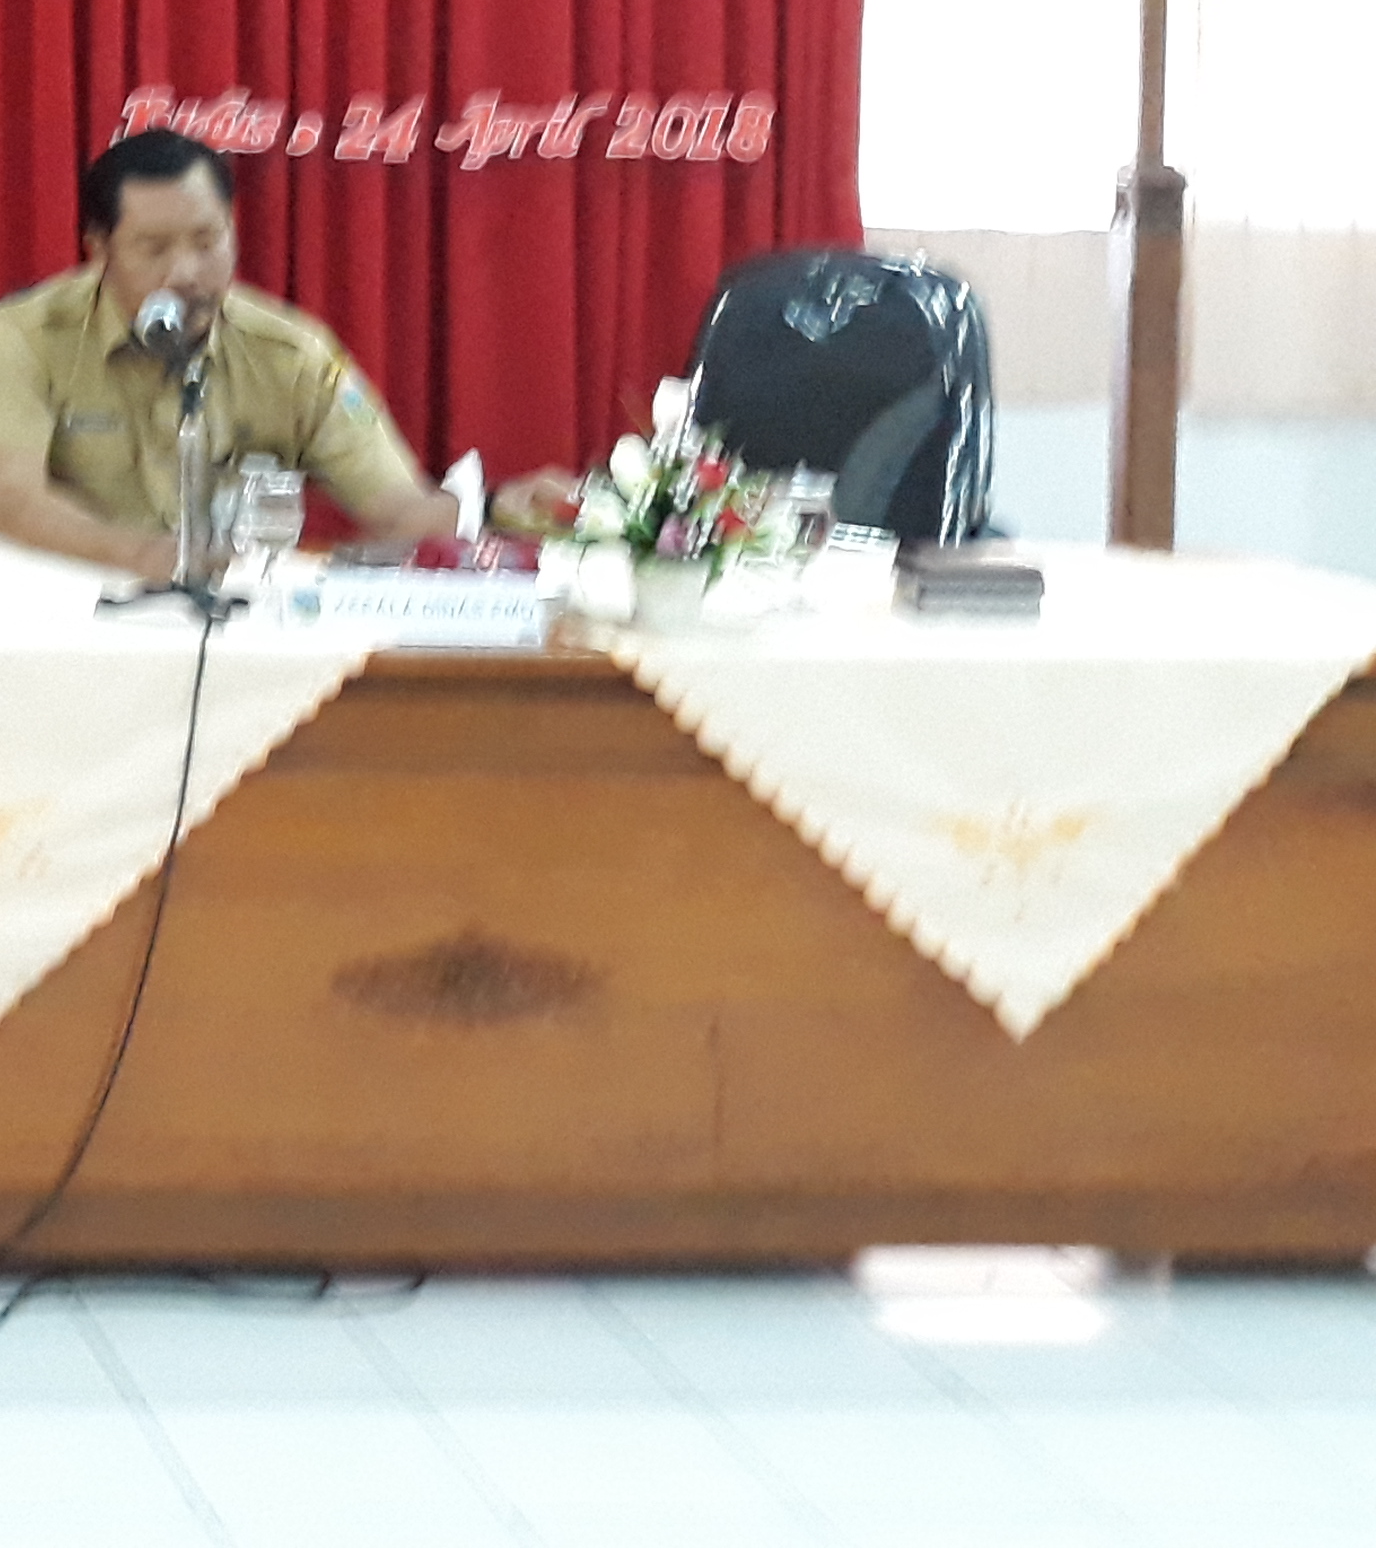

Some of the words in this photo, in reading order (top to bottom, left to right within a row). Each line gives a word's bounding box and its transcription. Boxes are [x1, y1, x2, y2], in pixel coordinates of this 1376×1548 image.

[334, 88, 428, 164] 24
[434, 88, 612, 171] April
[605, 89, 776, 163] 2018
